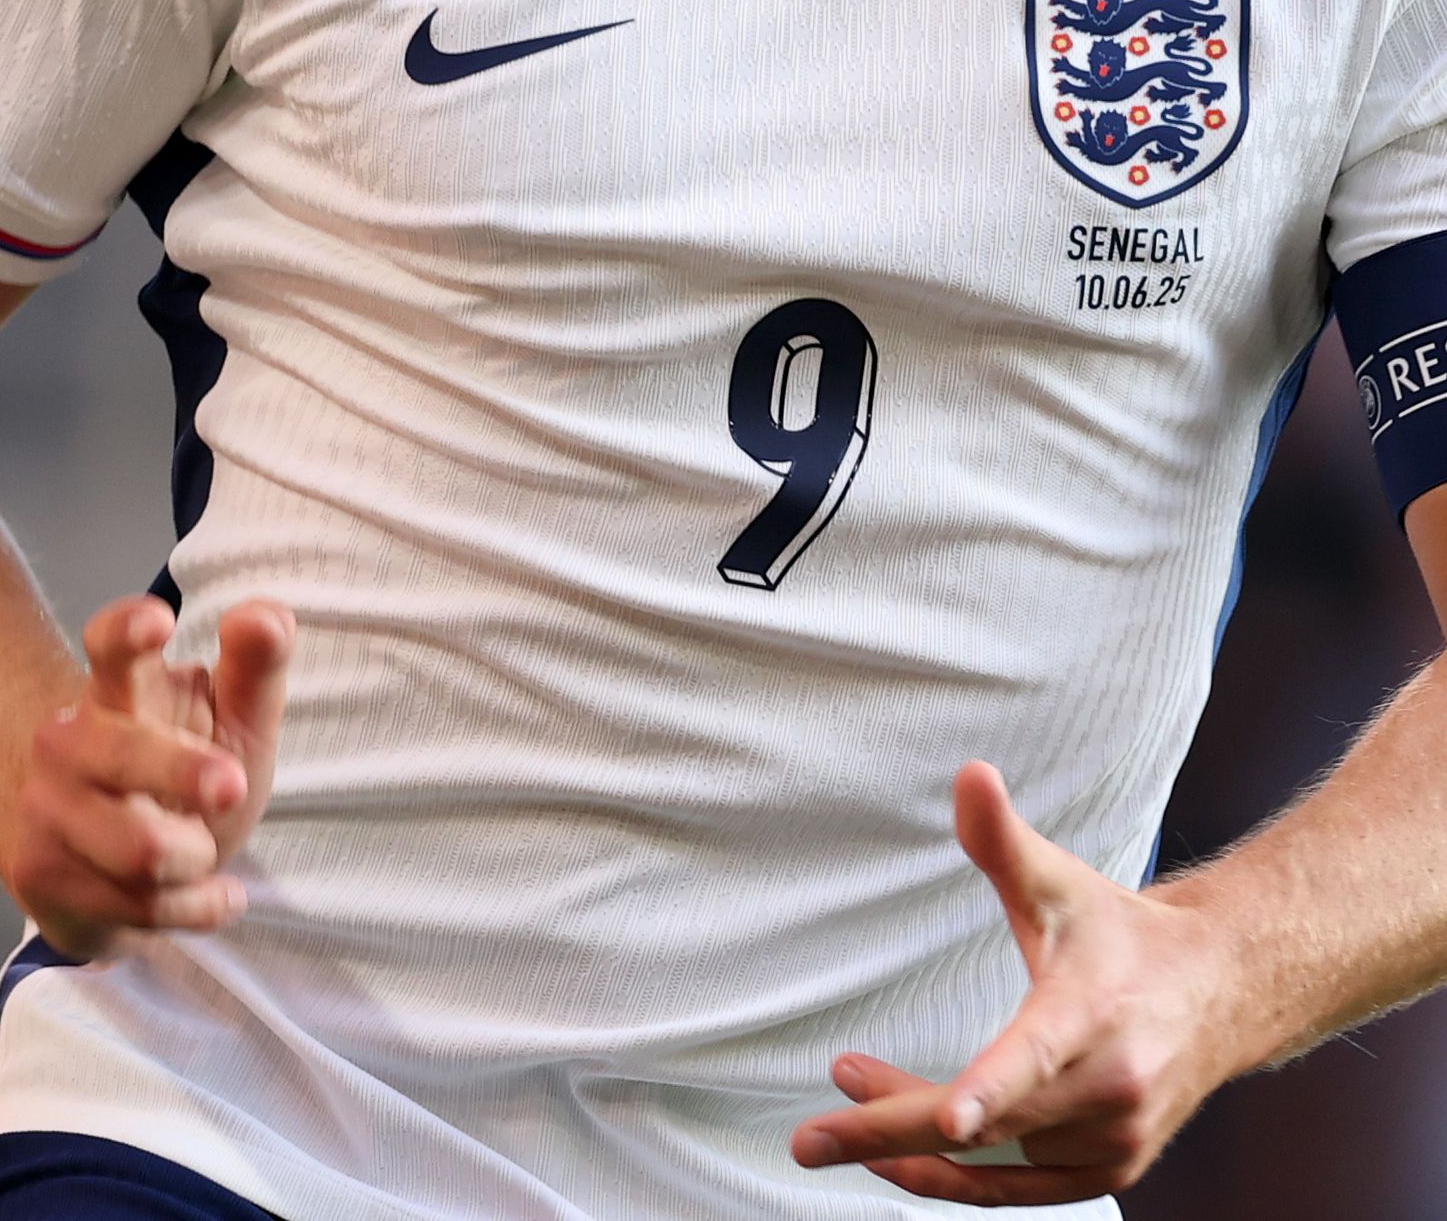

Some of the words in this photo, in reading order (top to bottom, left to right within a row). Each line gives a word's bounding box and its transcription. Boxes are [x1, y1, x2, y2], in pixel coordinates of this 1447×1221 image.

[1067, 225, 1204, 264] SENEGAL
[1075, 274, 1190, 310] 10.06.25
[717, 297, 878, 592] 9
